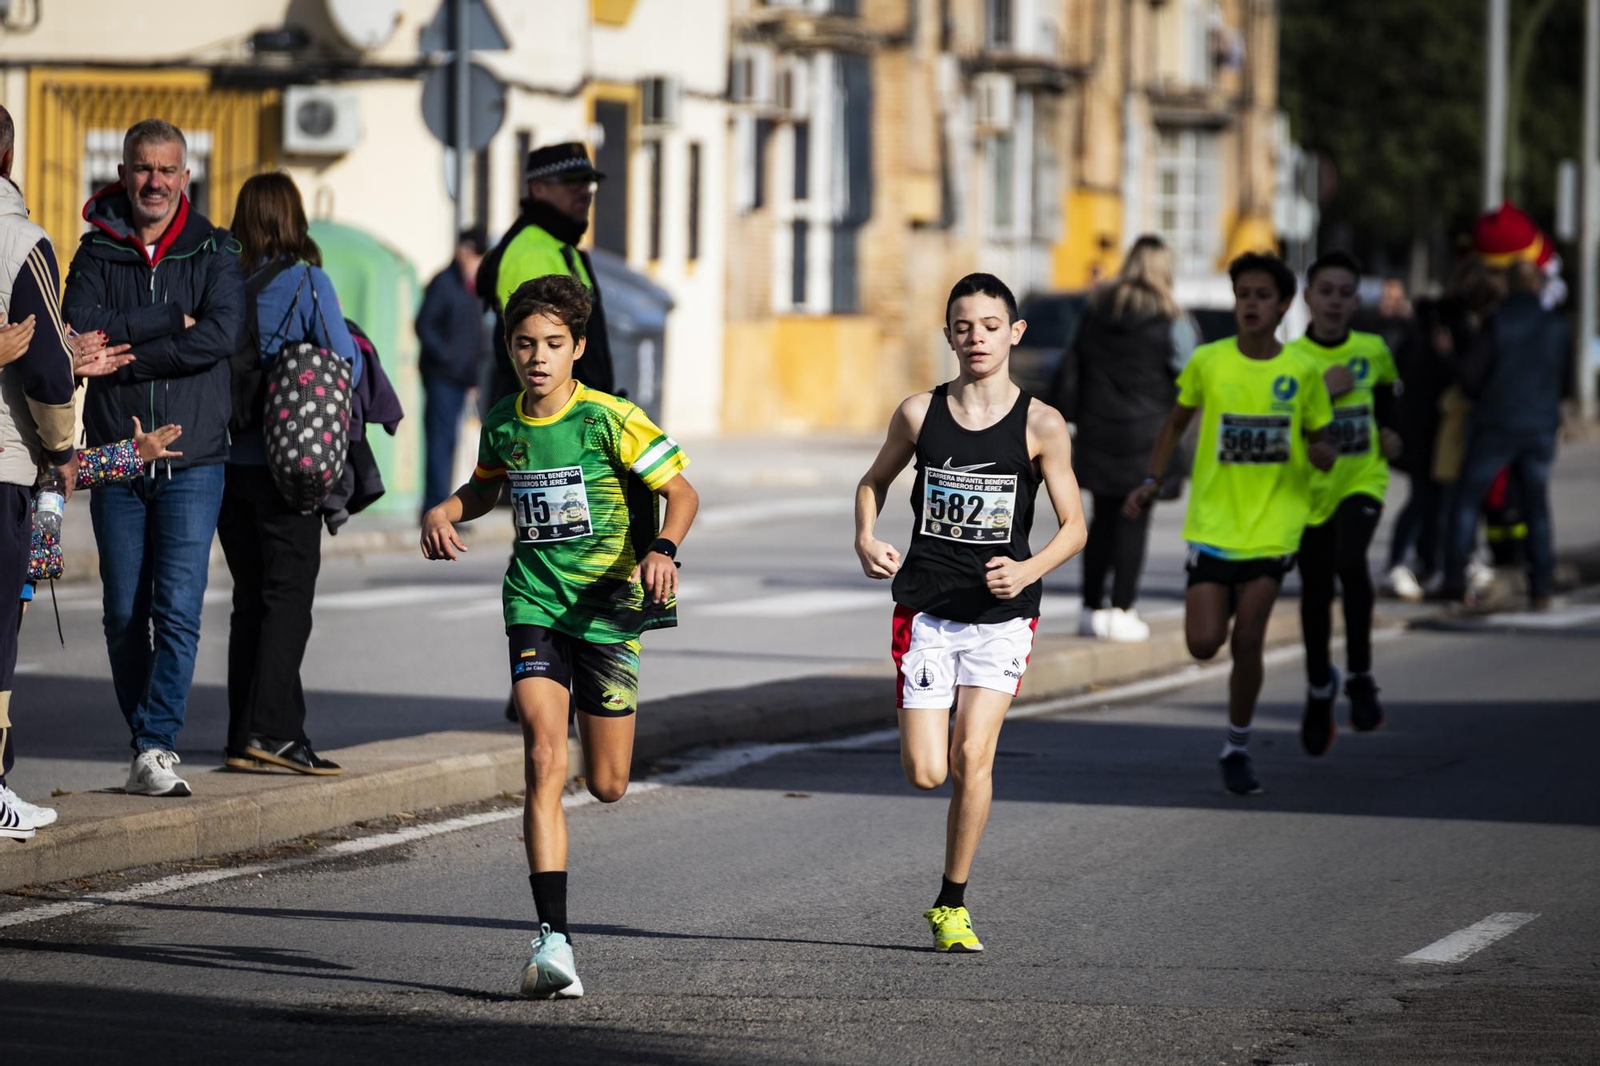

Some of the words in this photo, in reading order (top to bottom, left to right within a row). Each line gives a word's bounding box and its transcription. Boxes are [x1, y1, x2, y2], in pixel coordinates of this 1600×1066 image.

[1225, 428, 1266, 451] 584
[547, 470, 580, 479] BENÉFICA
[928, 471, 955, 481] CARRERA
[956, 476, 983, 485] INFANTIL
[984, 477, 1014, 485] BENÉFICA
[549, 478, 568, 486] JEREZ
[938, 480, 974, 490] BOMBEROS
[930, 489, 985, 526] 582
